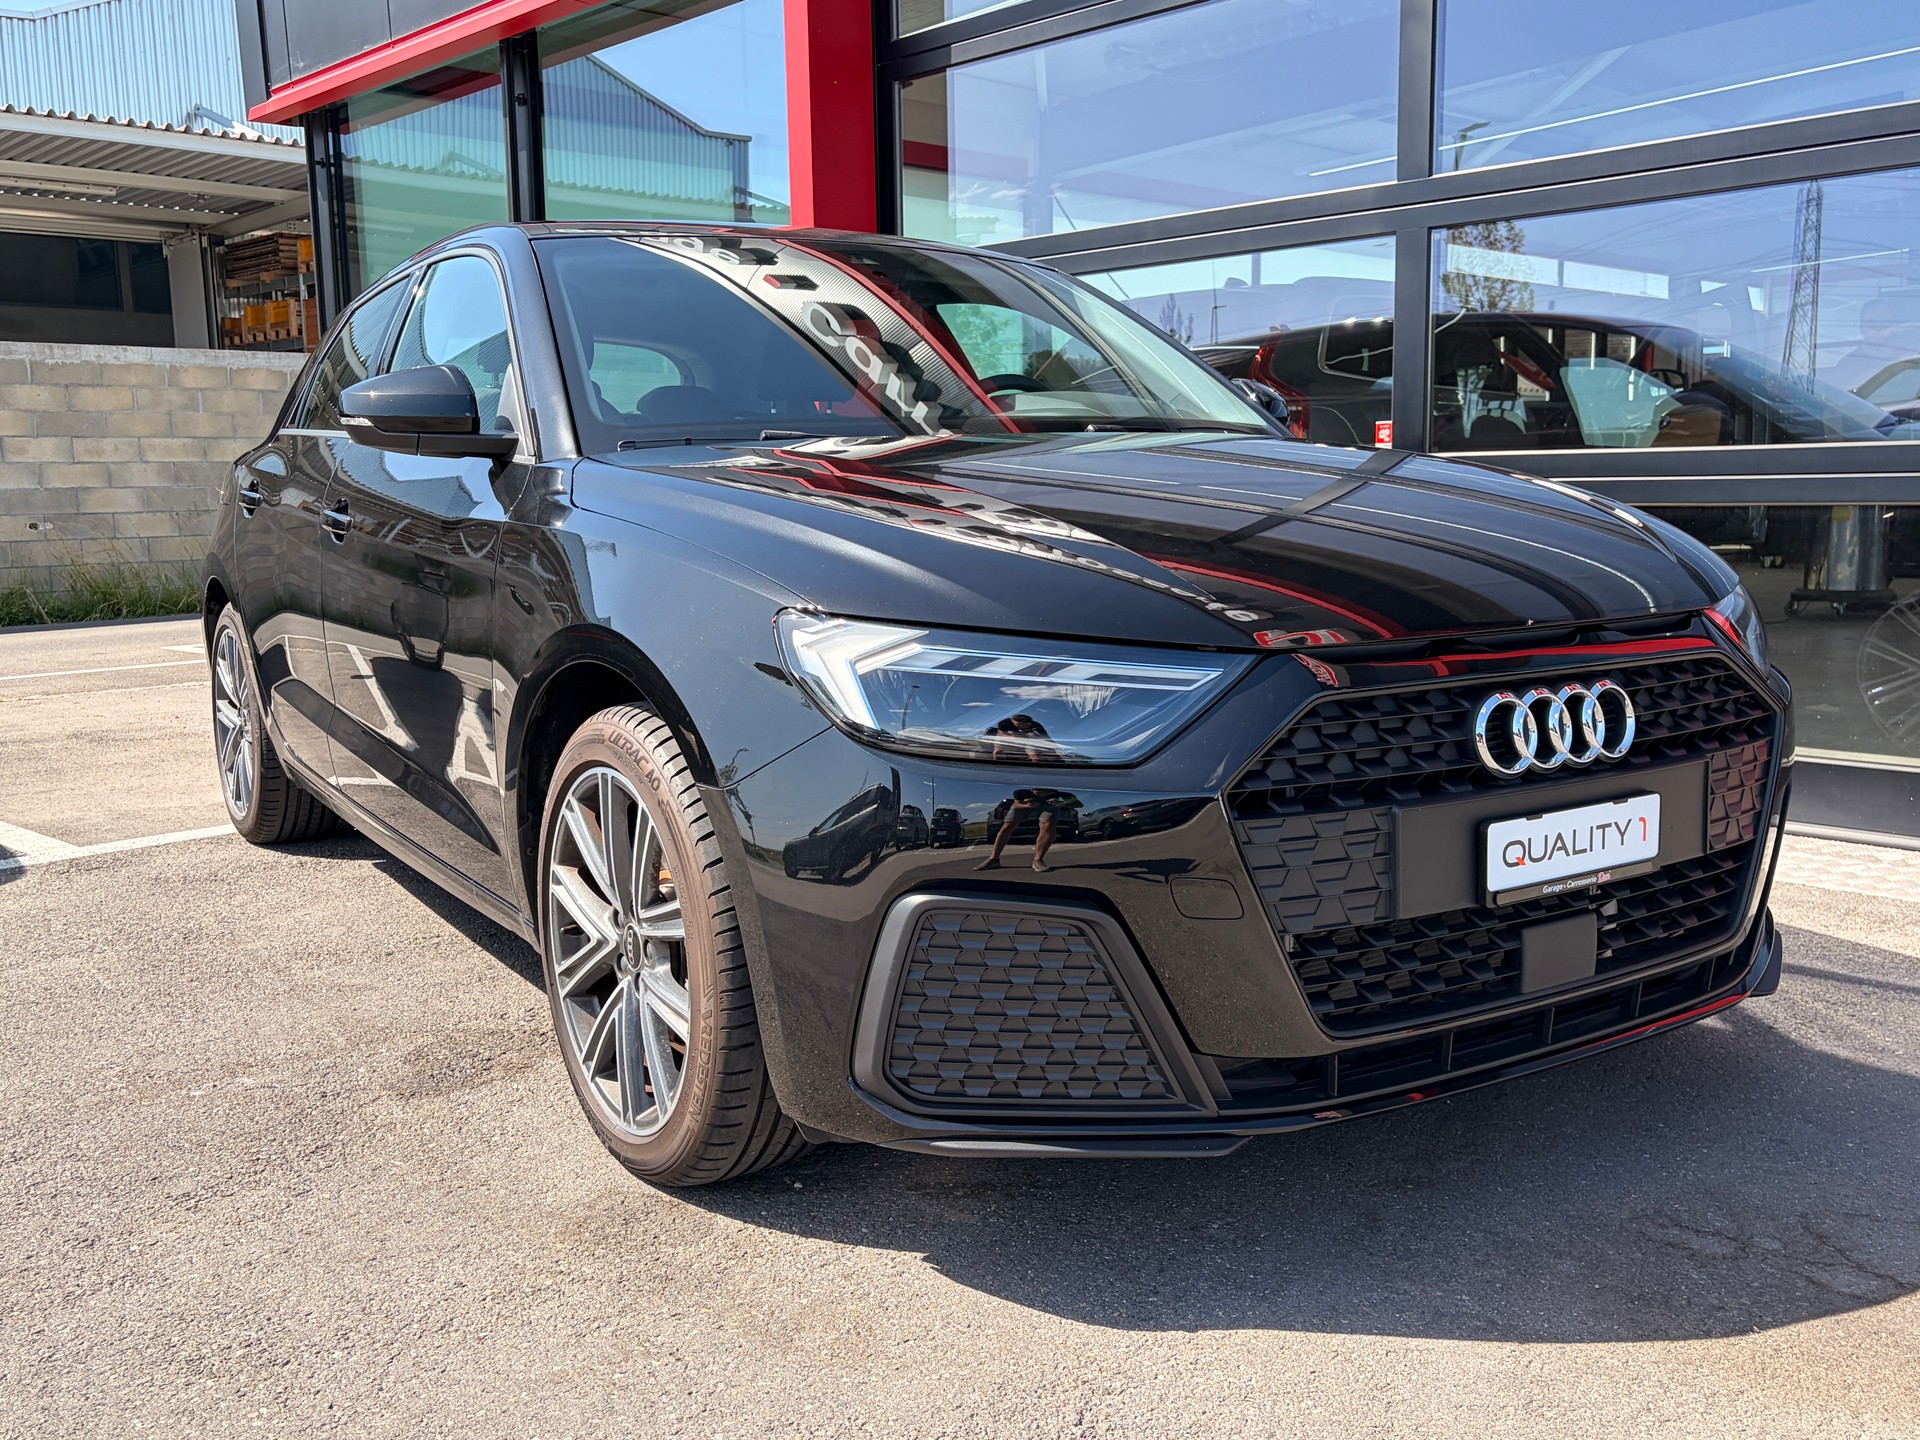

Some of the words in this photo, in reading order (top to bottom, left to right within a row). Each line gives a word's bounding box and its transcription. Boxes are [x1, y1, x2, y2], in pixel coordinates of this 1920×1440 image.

[607, 729, 650, 772] ULTRAC
[645, 768, 661, 793] AO
[1502, 818, 1633, 868] QUALITY
[1638, 816, 1647, 842] 1
[1542, 884, 1563, 894] Garage
[688, 1008, 713, 1124] VREDESTEIN
